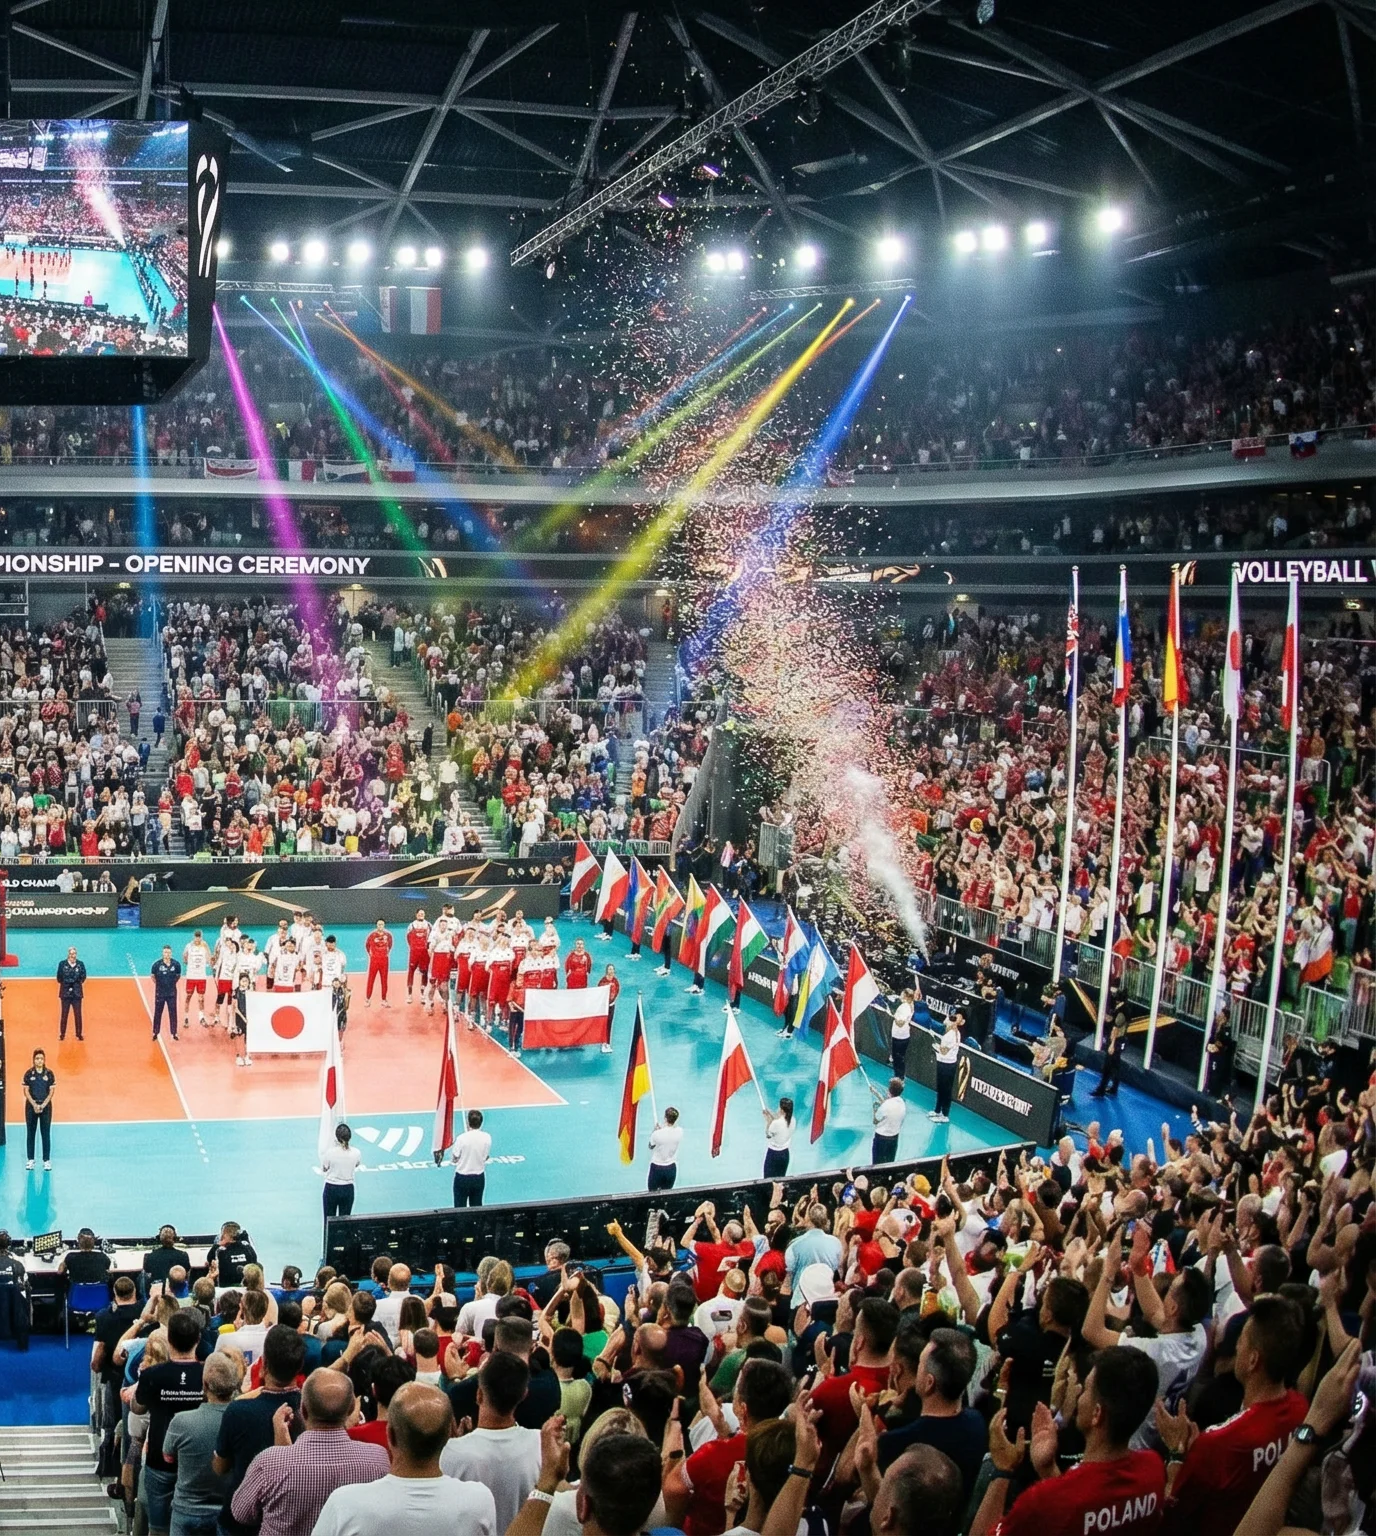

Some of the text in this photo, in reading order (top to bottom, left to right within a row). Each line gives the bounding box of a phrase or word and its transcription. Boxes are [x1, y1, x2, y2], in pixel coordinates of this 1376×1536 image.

[125, 555, 233, 573] OPENING
[238, 556, 371, 575] CEREMONY
[1236, 560, 1368, 583] VOLLEYBALL
[1253, 1438, 1285, 1472] POL
[1083, 1492, 1157, 1535] POLAND
